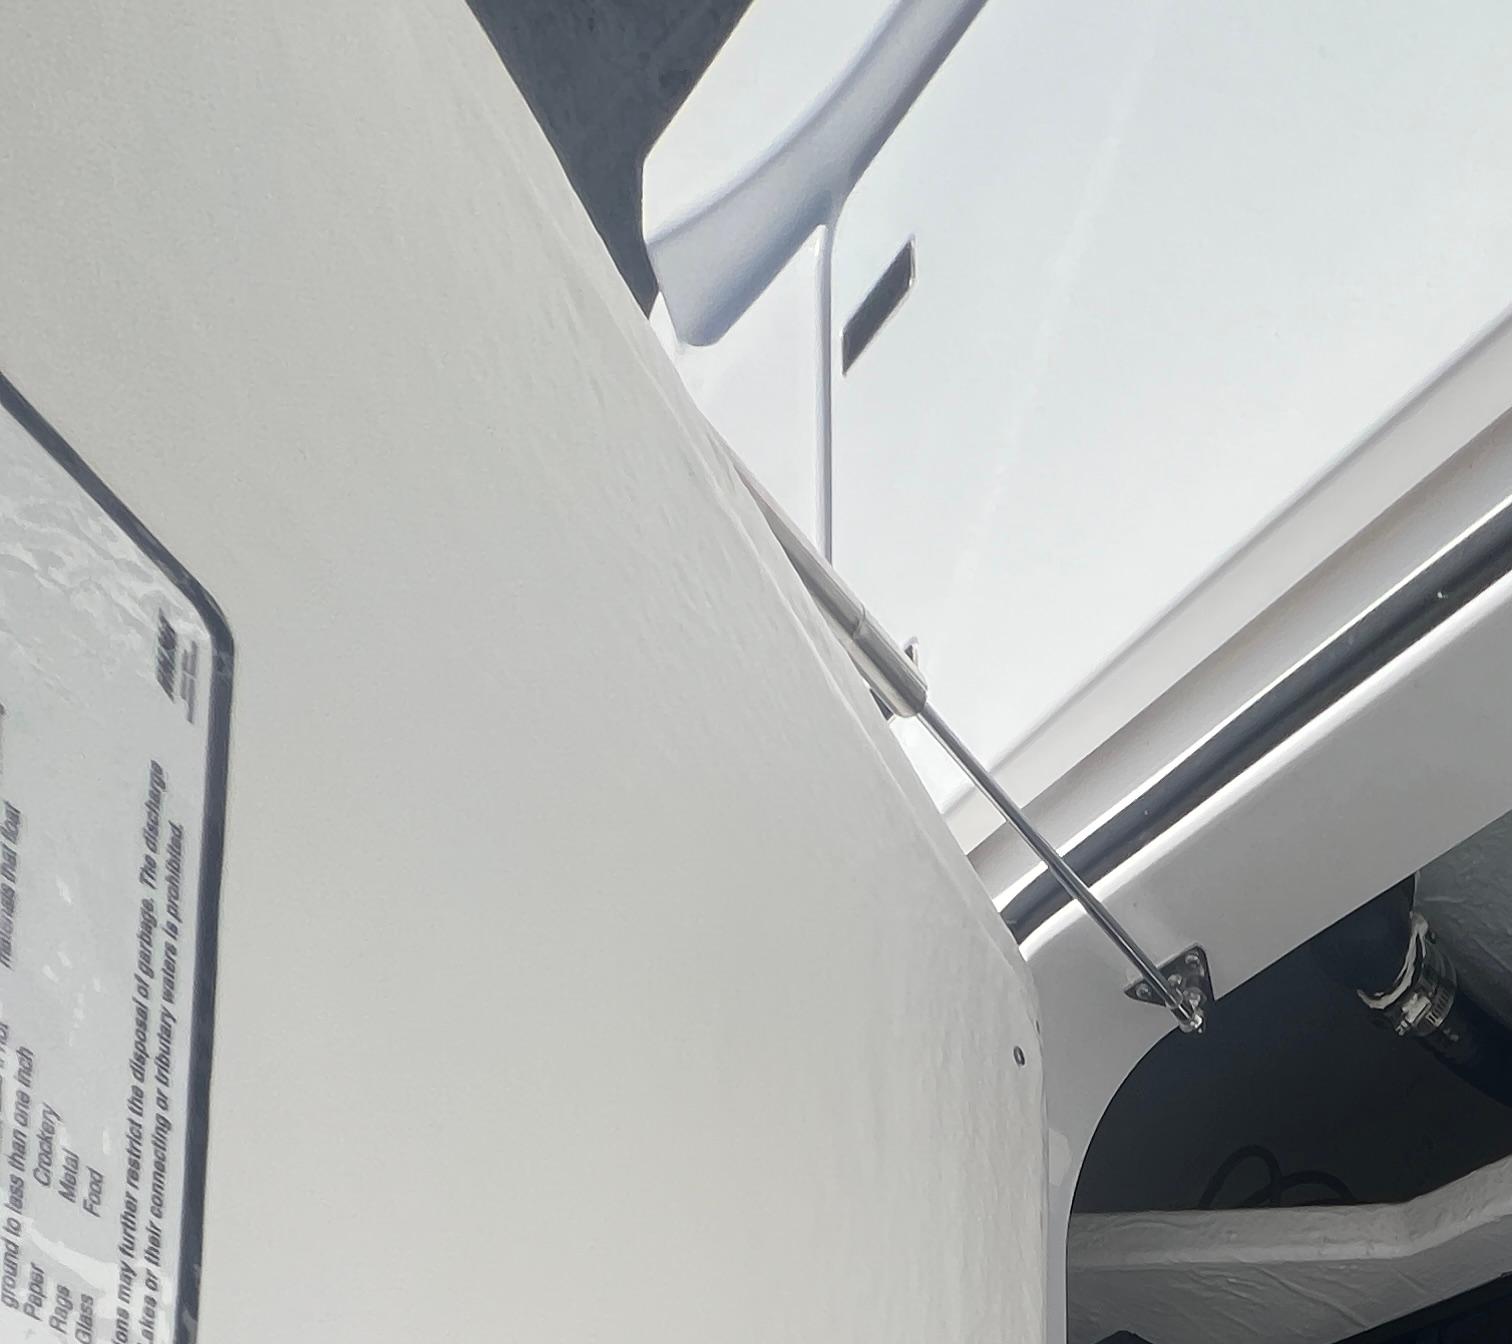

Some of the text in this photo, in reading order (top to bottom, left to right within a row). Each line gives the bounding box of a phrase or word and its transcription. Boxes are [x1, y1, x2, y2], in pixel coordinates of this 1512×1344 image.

[141, 759, 167, 853] discharge
[138, 855, 157, 890] The
[164, 821, 186, 921] prohibited.
[136, 896, 158, 978] garbage.
[163, 925, 179, 940] is
[132, 974, 151, 999] of
[160, 943, 179, 1005] waters
[129, 999, 153, 1082] disposal
[152, 1007, 176, 1088] tributary
[12, 1046, 34, 1088] inch
[14, 1090, 30, 1127] one
[127, 1085, 145, 1117] the
[153, 1087, 170, 1110] or
[6, 1128, 28, 1172] than
[32, 1102, 61, 1187] Crockery
[124, 1119, 144, 1188] restrict
[148, 1113, 172, 1219] connecting
[2, 1174, 24, 1214] less
[57, 1148, 80, 1203] Metal
[83, 1166, 104, 1218] Food
[2, 1218, 21, 1237] to
[118, 1193, 140, 1258] further
[142, 1221, 162, 1267] their
[1, 1237, 19, 1310] ground
[23, 1262, 45, 1322] Paper
[118, 1260, 138, 1305] may
[144, 1268, 160, 1292] or
[49, 1284, 72, 1334] Rags
